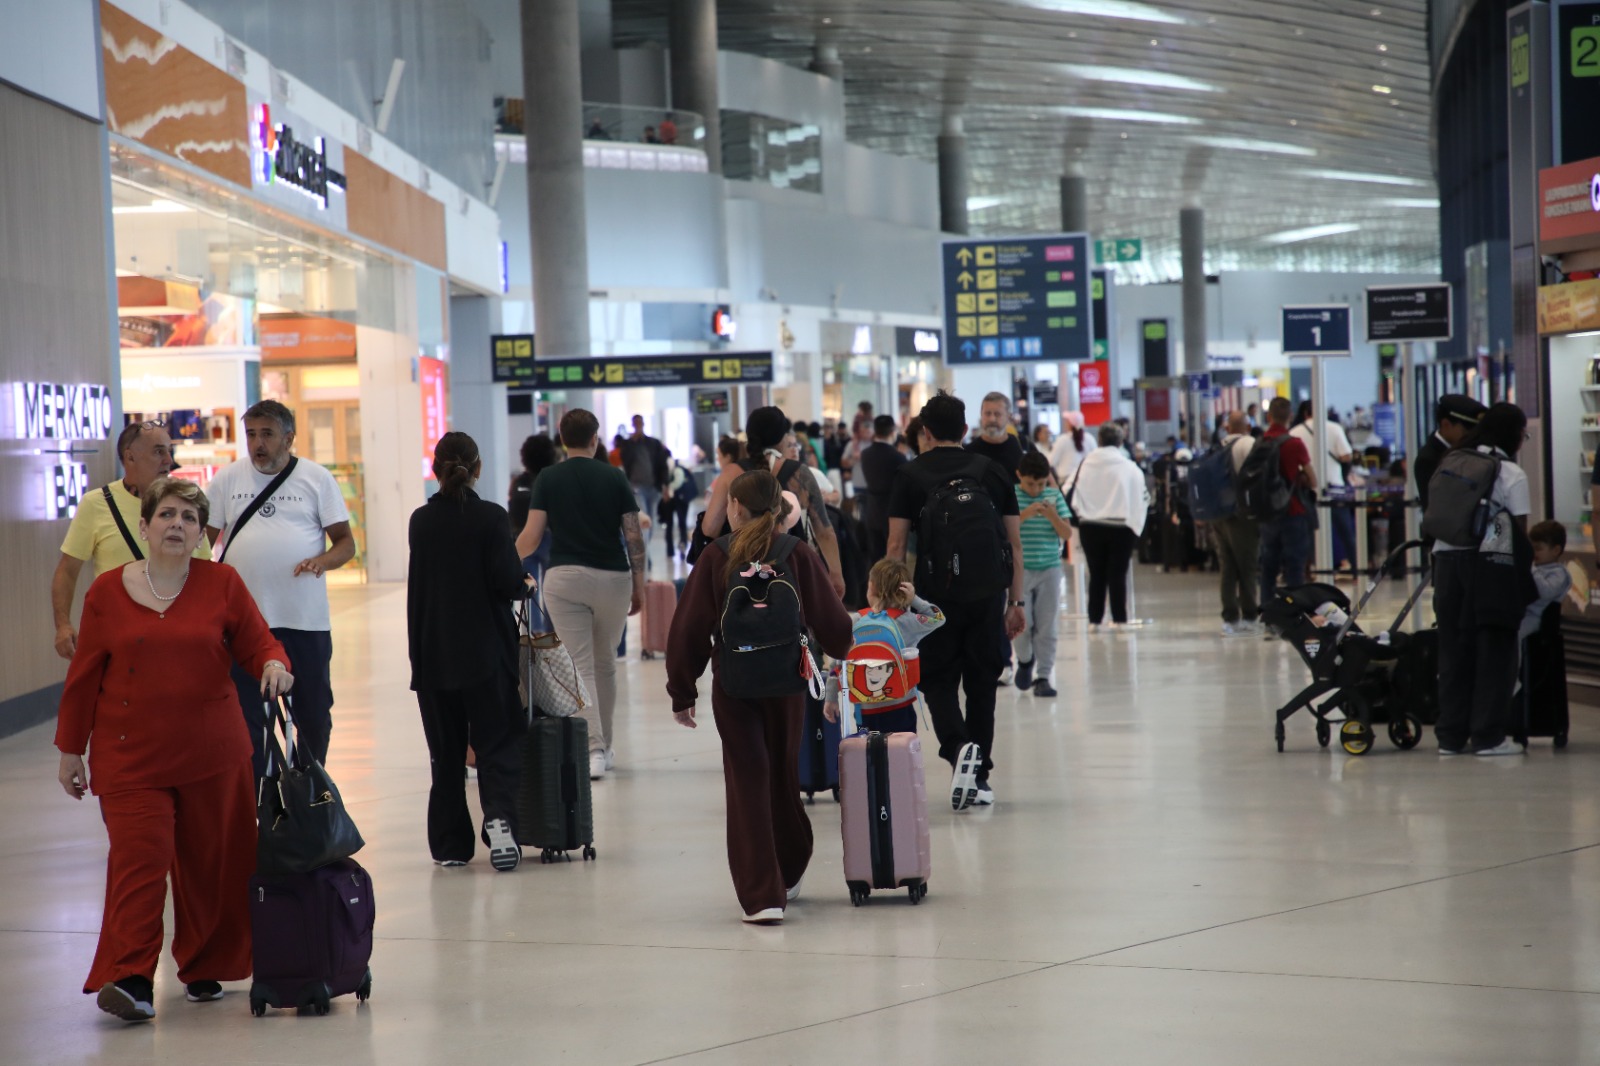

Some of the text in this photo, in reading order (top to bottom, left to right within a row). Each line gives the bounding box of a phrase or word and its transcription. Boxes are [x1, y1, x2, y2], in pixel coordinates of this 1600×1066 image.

[1310, 325, 1322, 347] 1
[23, 383, 113, 439] MERKATO
[231, 493, 304, 502] ABEROMBIE
